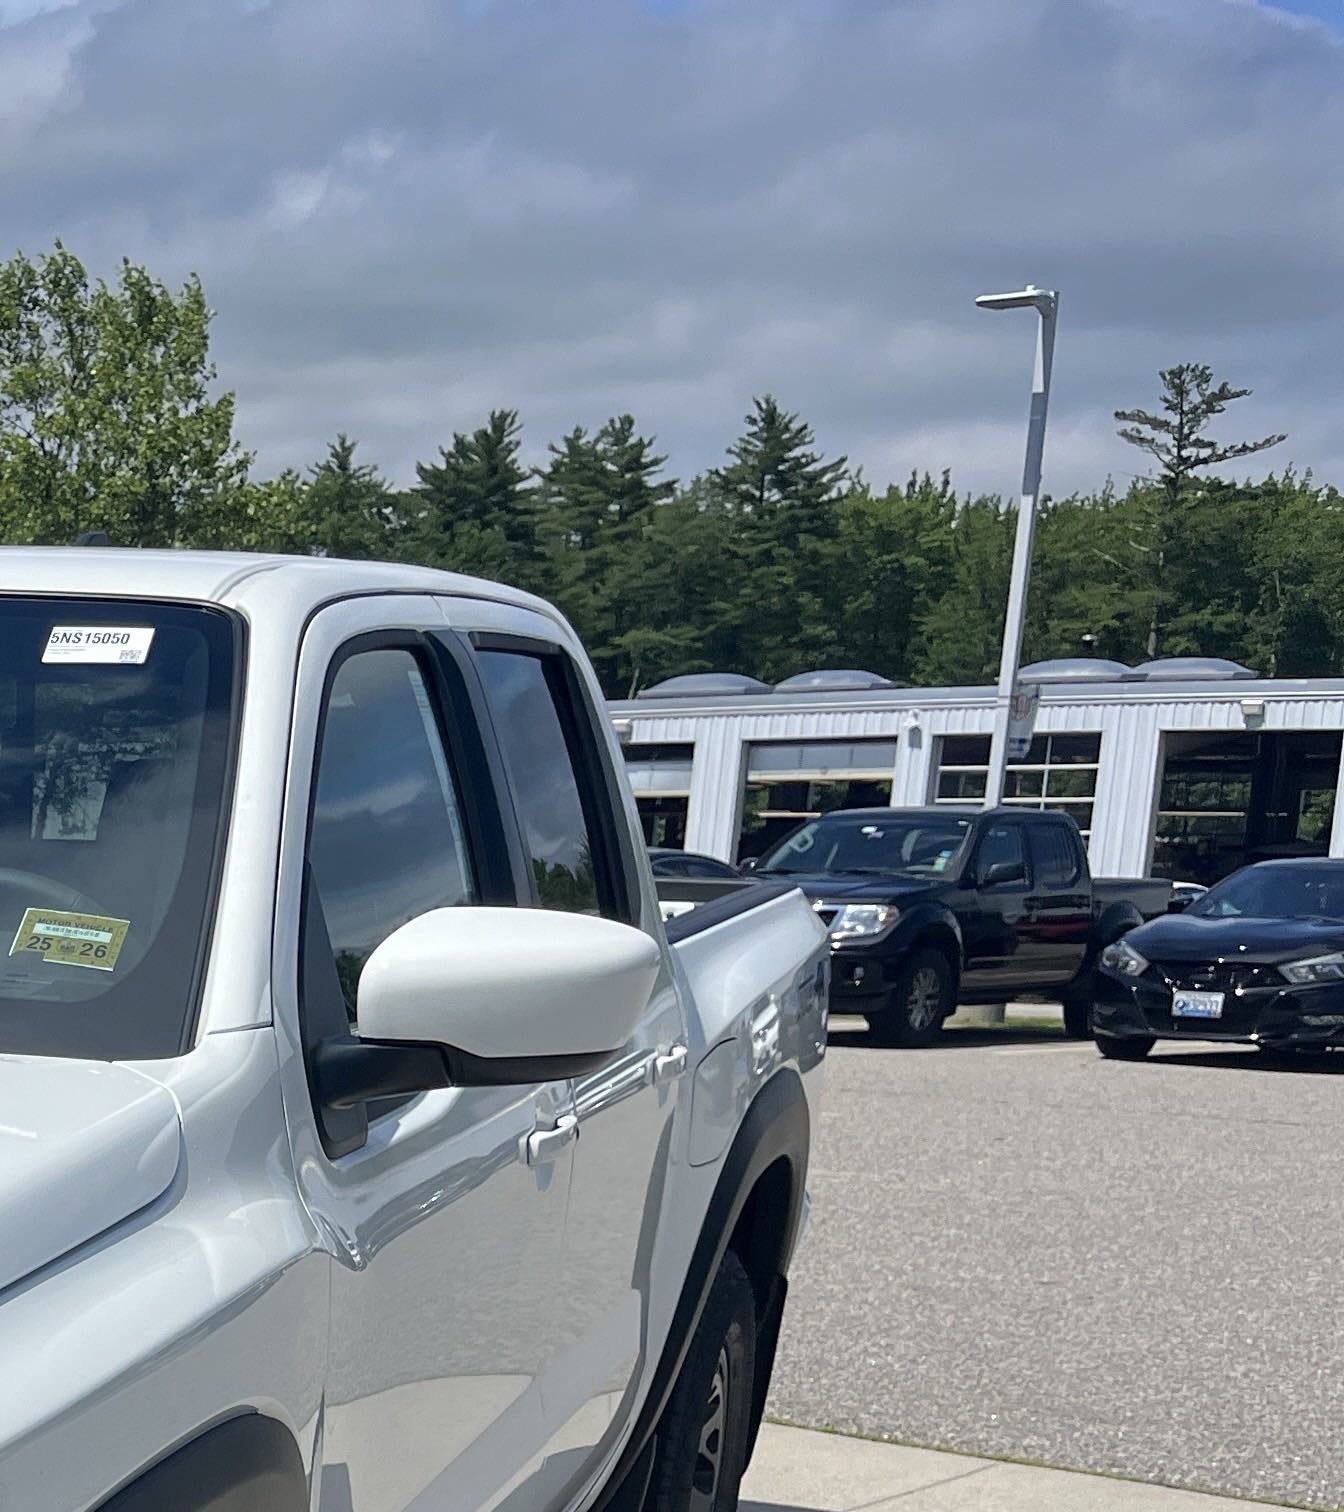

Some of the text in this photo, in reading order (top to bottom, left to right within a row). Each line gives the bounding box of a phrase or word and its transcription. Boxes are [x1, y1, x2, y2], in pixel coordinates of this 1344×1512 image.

[50, 632, 131, 645] 5NS15050
[26, 936, 53, 951] 25
[79, 943, 108, 958] 26
